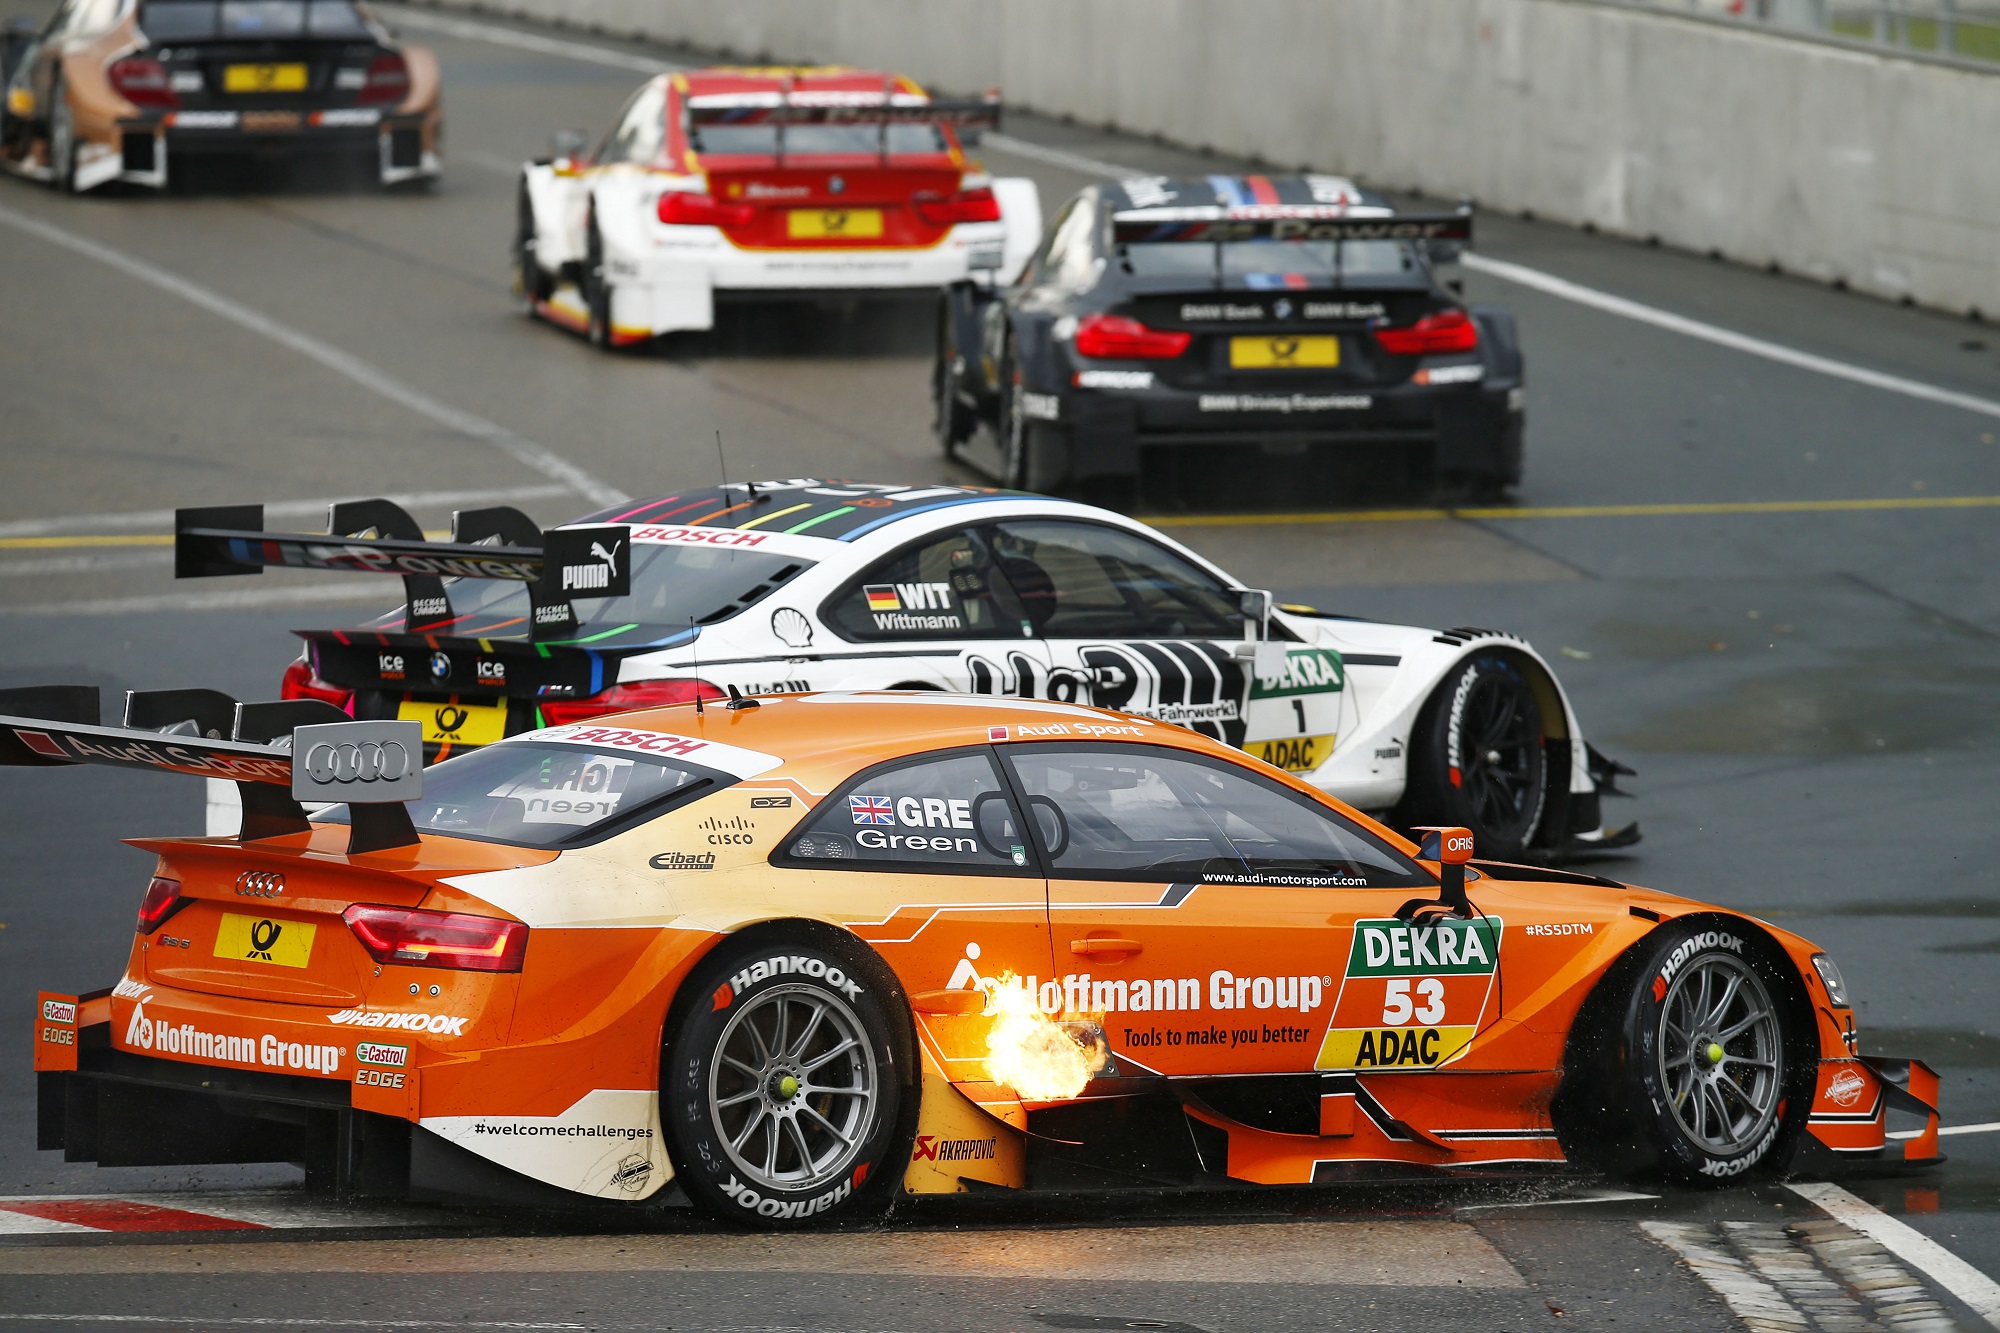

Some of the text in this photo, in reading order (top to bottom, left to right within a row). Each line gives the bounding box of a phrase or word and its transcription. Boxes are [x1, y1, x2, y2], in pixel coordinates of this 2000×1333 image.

[631, 528, 768, 547] BOSCH
[343, 545, 540, 581] Power
[562, 563, 608, 590] PUMA
[413, 597, 447, 607] BECKER
[898, 583, 951, 610] WIT
[413, 605, 447, 616] CARBON
[536, 604, 569, 614] BECKER
[536, 613, 569, 624] CARBON
[873, 612, 961, 631] Wittmann
[379, 651, 404, 670] ice
[476, 656, 505, 676] ice
[380, 671, 405, 680] watch
[477, 678, 506, 686] watch
[1159, 704, 1236, 720] Fahrwerk!
[1292, 699, 1306, 733] 1
[1018, 723, 1144, 739] Audi Sport
[567, 727, 709, 756] BOSCH
[64, 735, 291, 779] Audi Sport
[1262, 738, 1314, 768] ADAC
[897, 796, 974, 829] GRE
[855, 829, 978, 852] Green
[1447, 837, 1475, 852] ORIS
[648, 851, 716, 869] Eibach
[1202, 871, 1367, 888] www.audi-motorsport.com
[1525, 923, 1593, 936] #RS5DTM
[1364, 925, 1489, 968] DEKRA
[1012, 973, 1200, 1014] Hoffmann
[1382, 978, 1446, 1027] 53
[50, 1003, 74, 1021] Castrol
[42, 1027, 75, 1045] EDGE
[156, 1020, 257, 1064] Hoffmann
[1124, 1024, 1310, 1050] Tools to make you better
[367, 1045, 405, 1065] Castrol
[1354, 1028, 1440, 1067] ADAC
[355, 1069, 406, 1089] EDGE
[475, 1123, 654, 1140] #welcomechallenges
